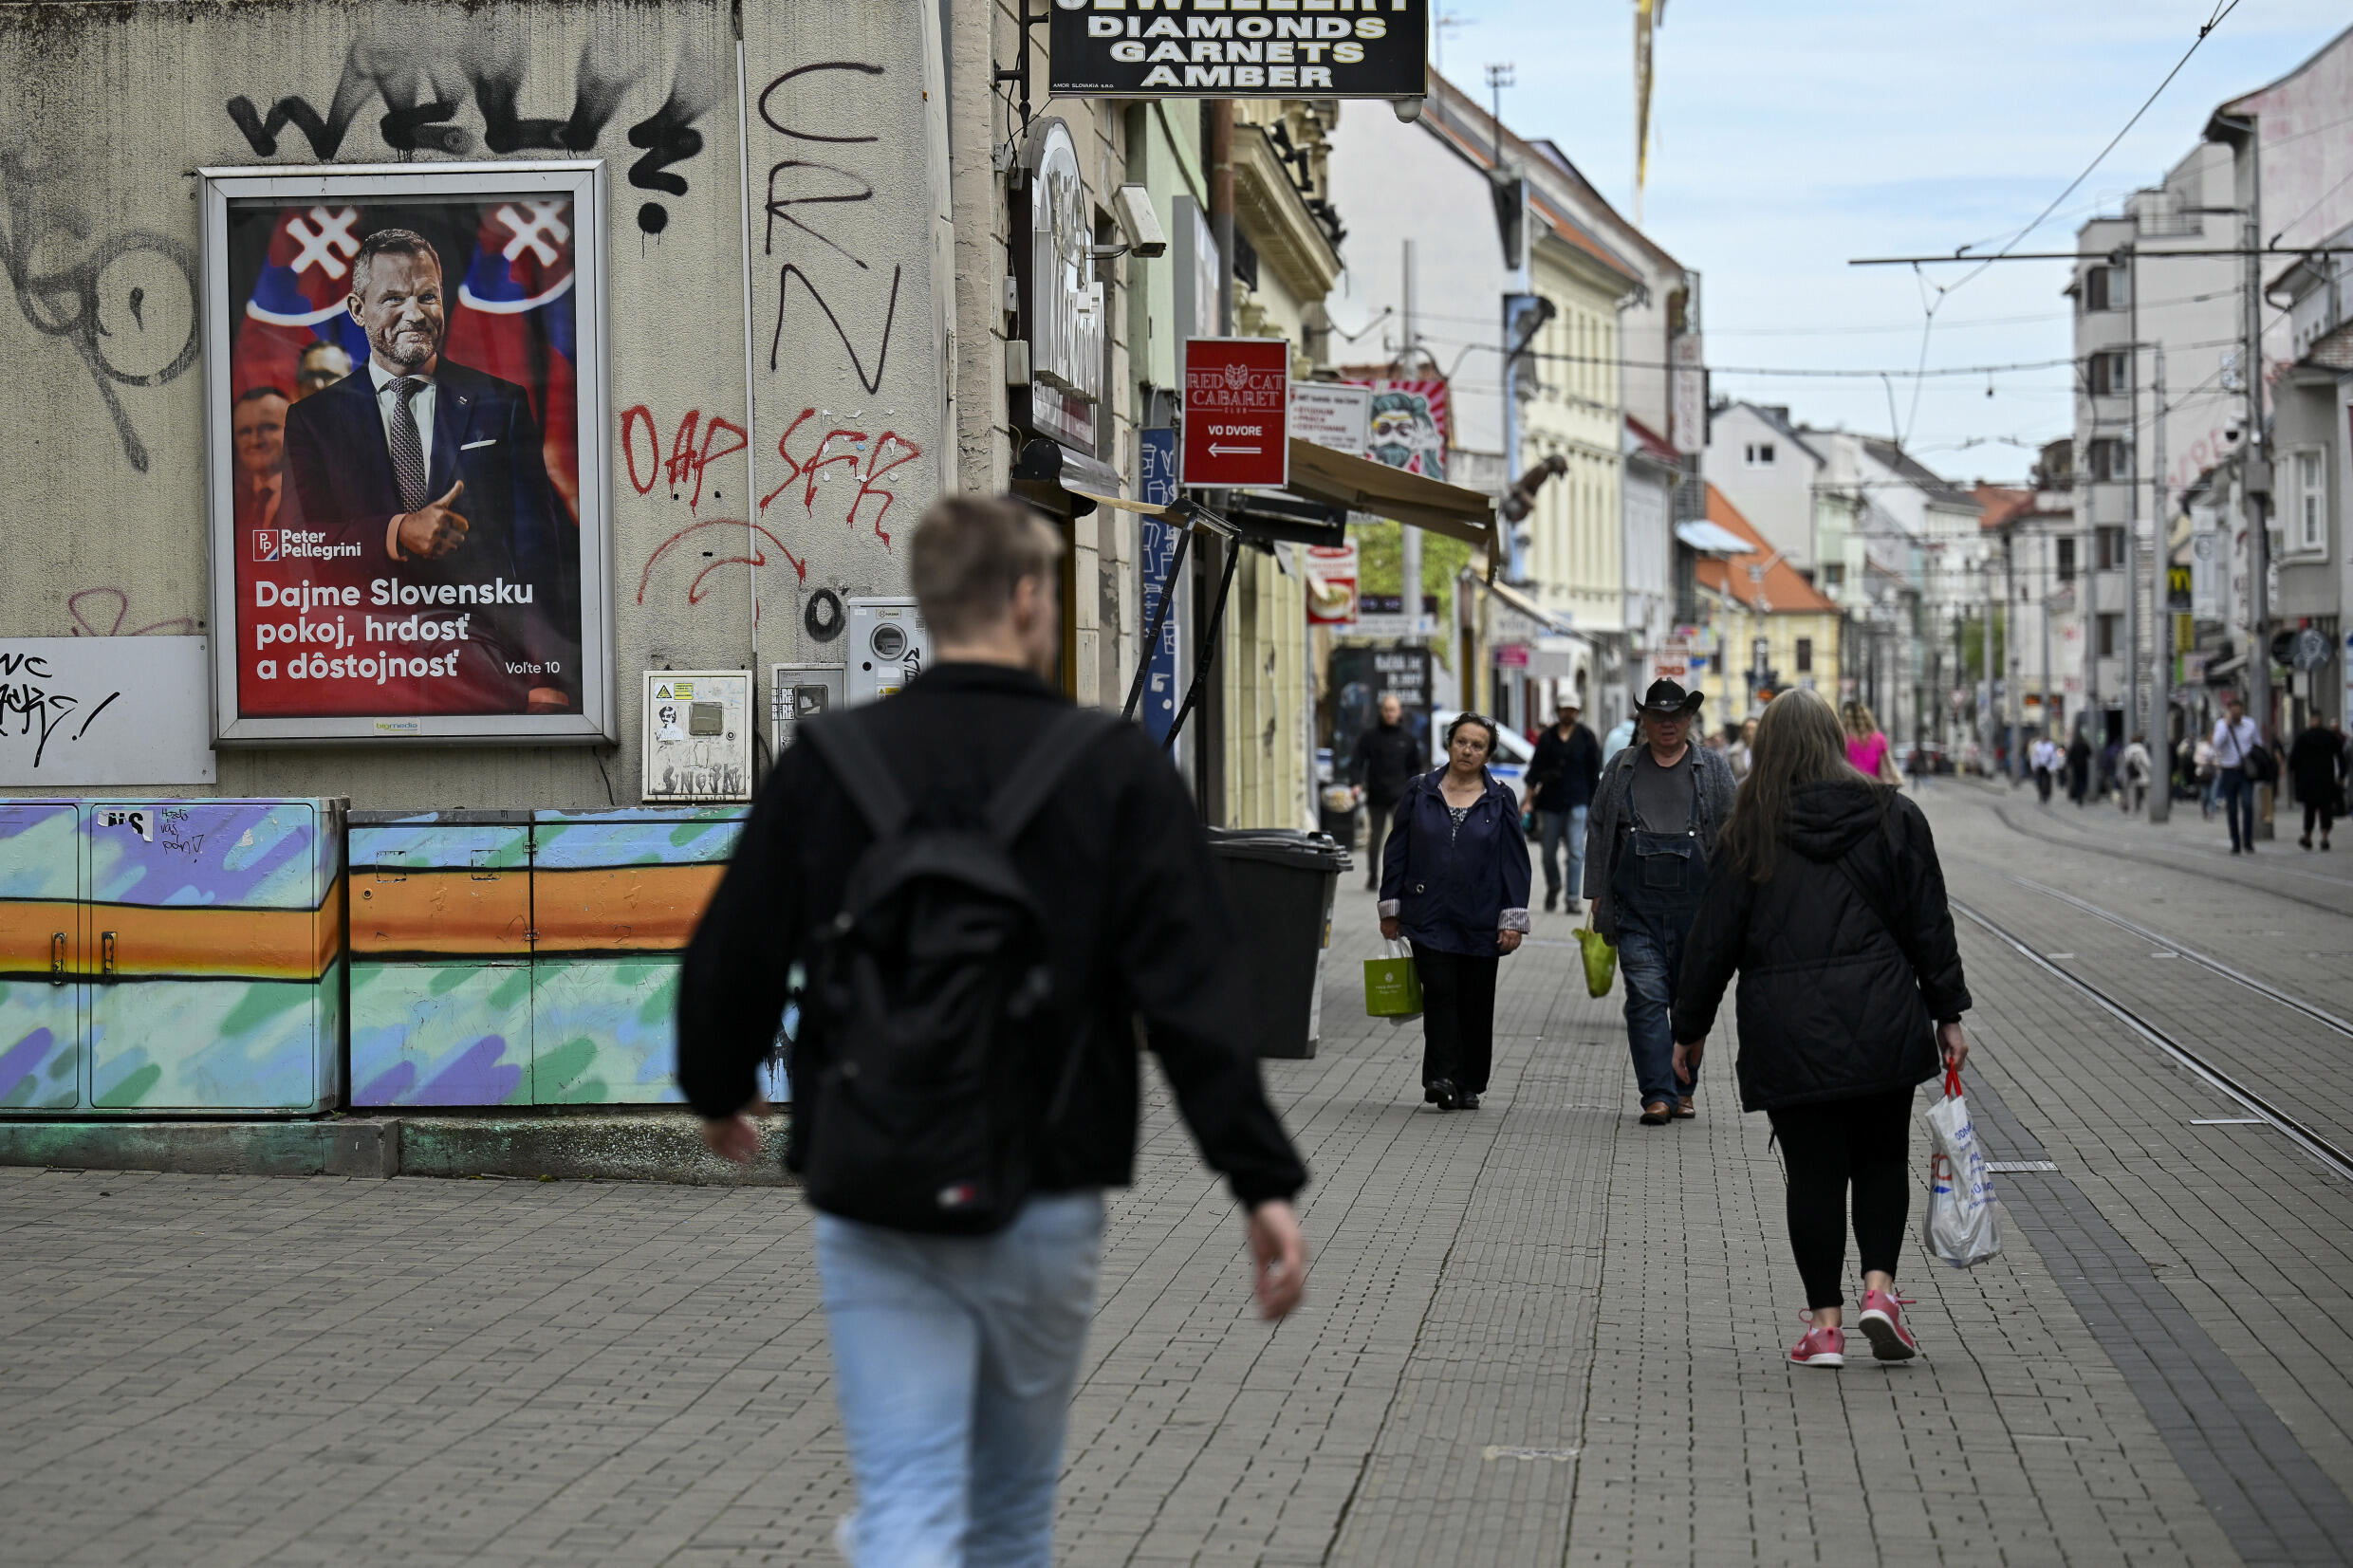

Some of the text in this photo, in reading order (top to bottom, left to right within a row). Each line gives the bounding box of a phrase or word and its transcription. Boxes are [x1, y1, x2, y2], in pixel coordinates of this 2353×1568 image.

[1087, 16, 1387, 39] DIAMONDS
[1110, 41, 1364, 63] GARNETS
[1139, 65, 1333, 87] AMBER
[1186, 373, 1285, 390] RED CAT
[1192, 390, 1279, 406] CABARET
[1208, 425, 1263, 436] VO DVORE
[281, 529, 326, 544] Peter
[281, 542, 361, 561] Pellegrini
[255, 578, 533, 615] Dajme Slovensku
[256, 613, 471, 651] pokoj, hrdosť
[256, 649, 460, 685] a dôstojnosť
[505, 661, 561, 674] Voľte 10
